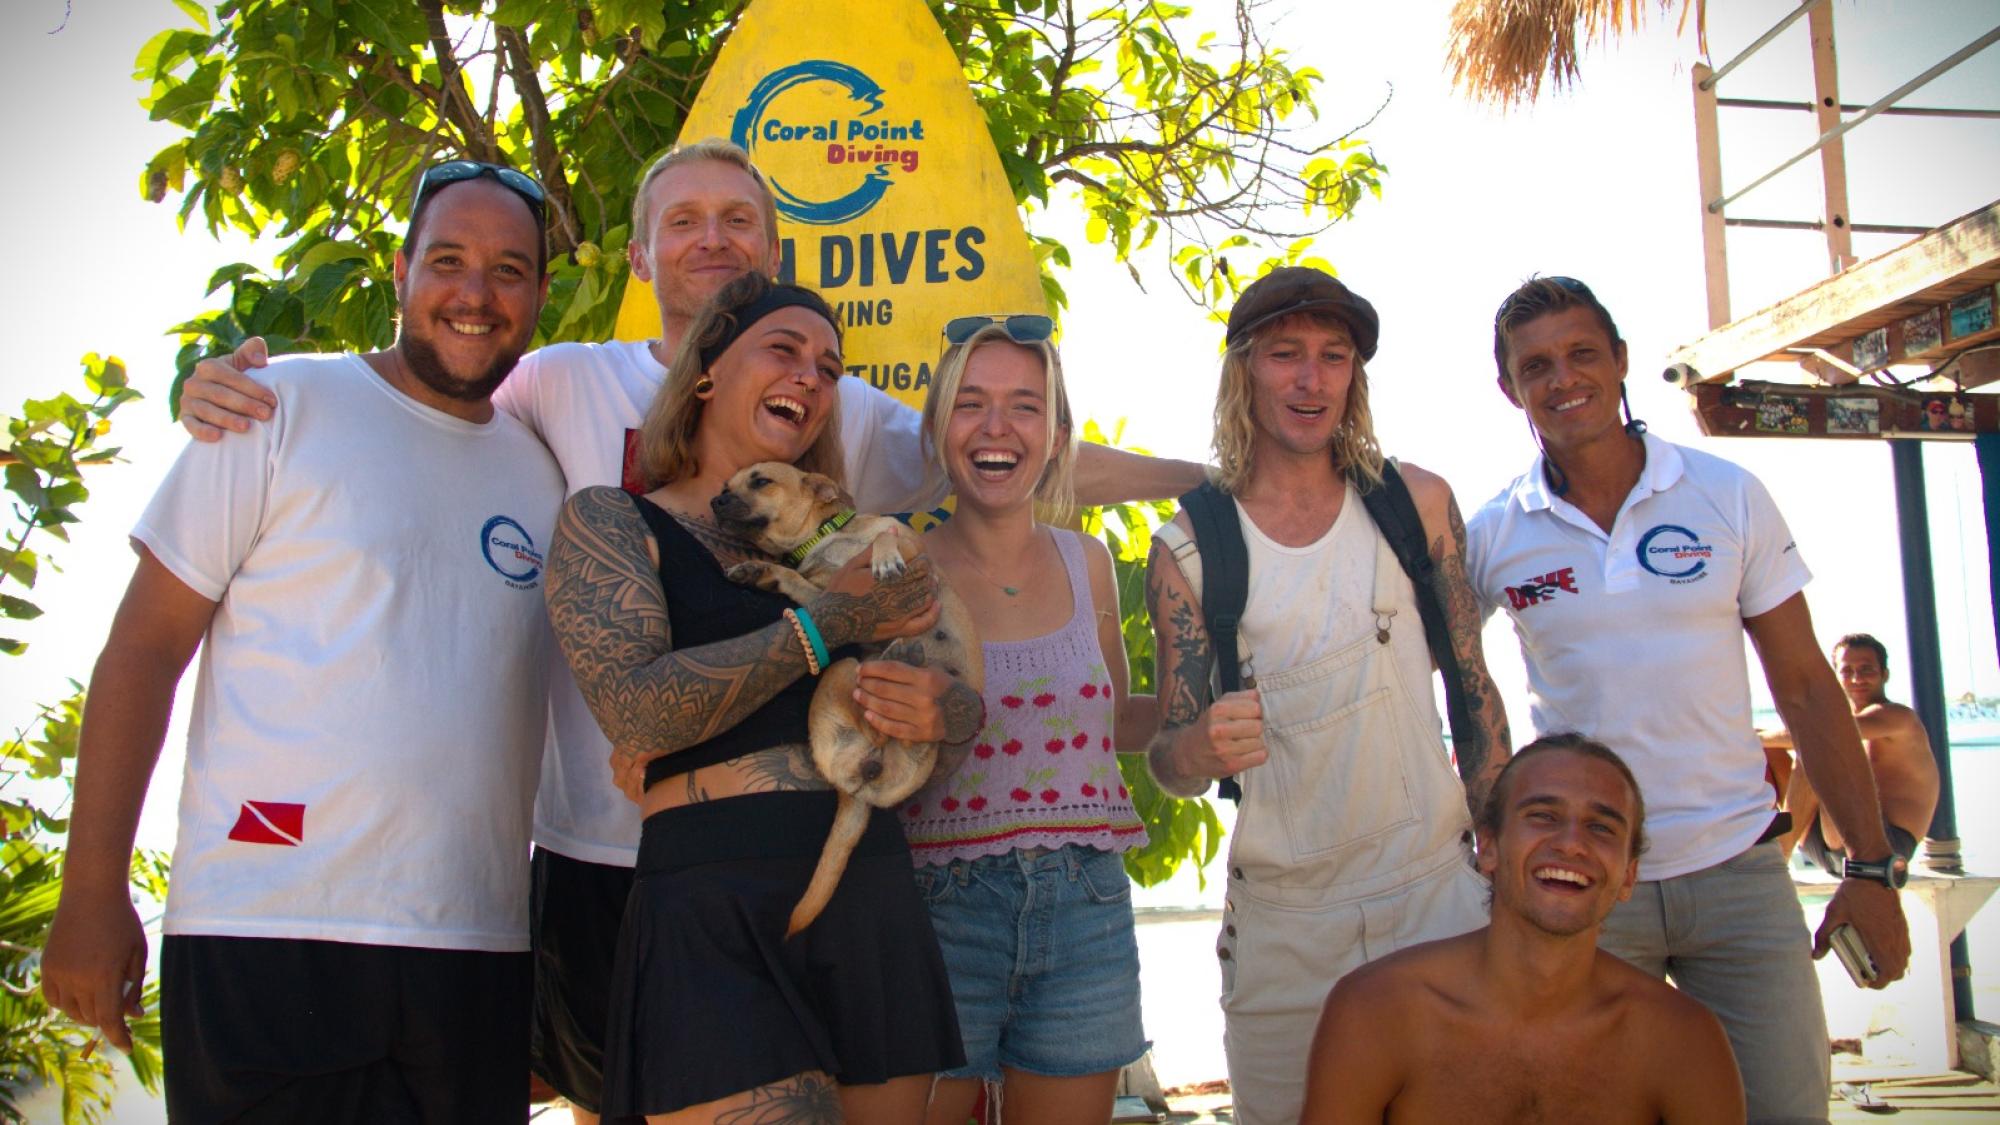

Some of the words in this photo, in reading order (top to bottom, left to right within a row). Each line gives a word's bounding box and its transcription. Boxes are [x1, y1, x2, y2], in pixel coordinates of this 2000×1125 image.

[763, 119, 837, 141] Coral
[847, 119, 924, 141] Point
[827, 143, 919, 172] Diving
[820, 226, 985, 289] DIVES
